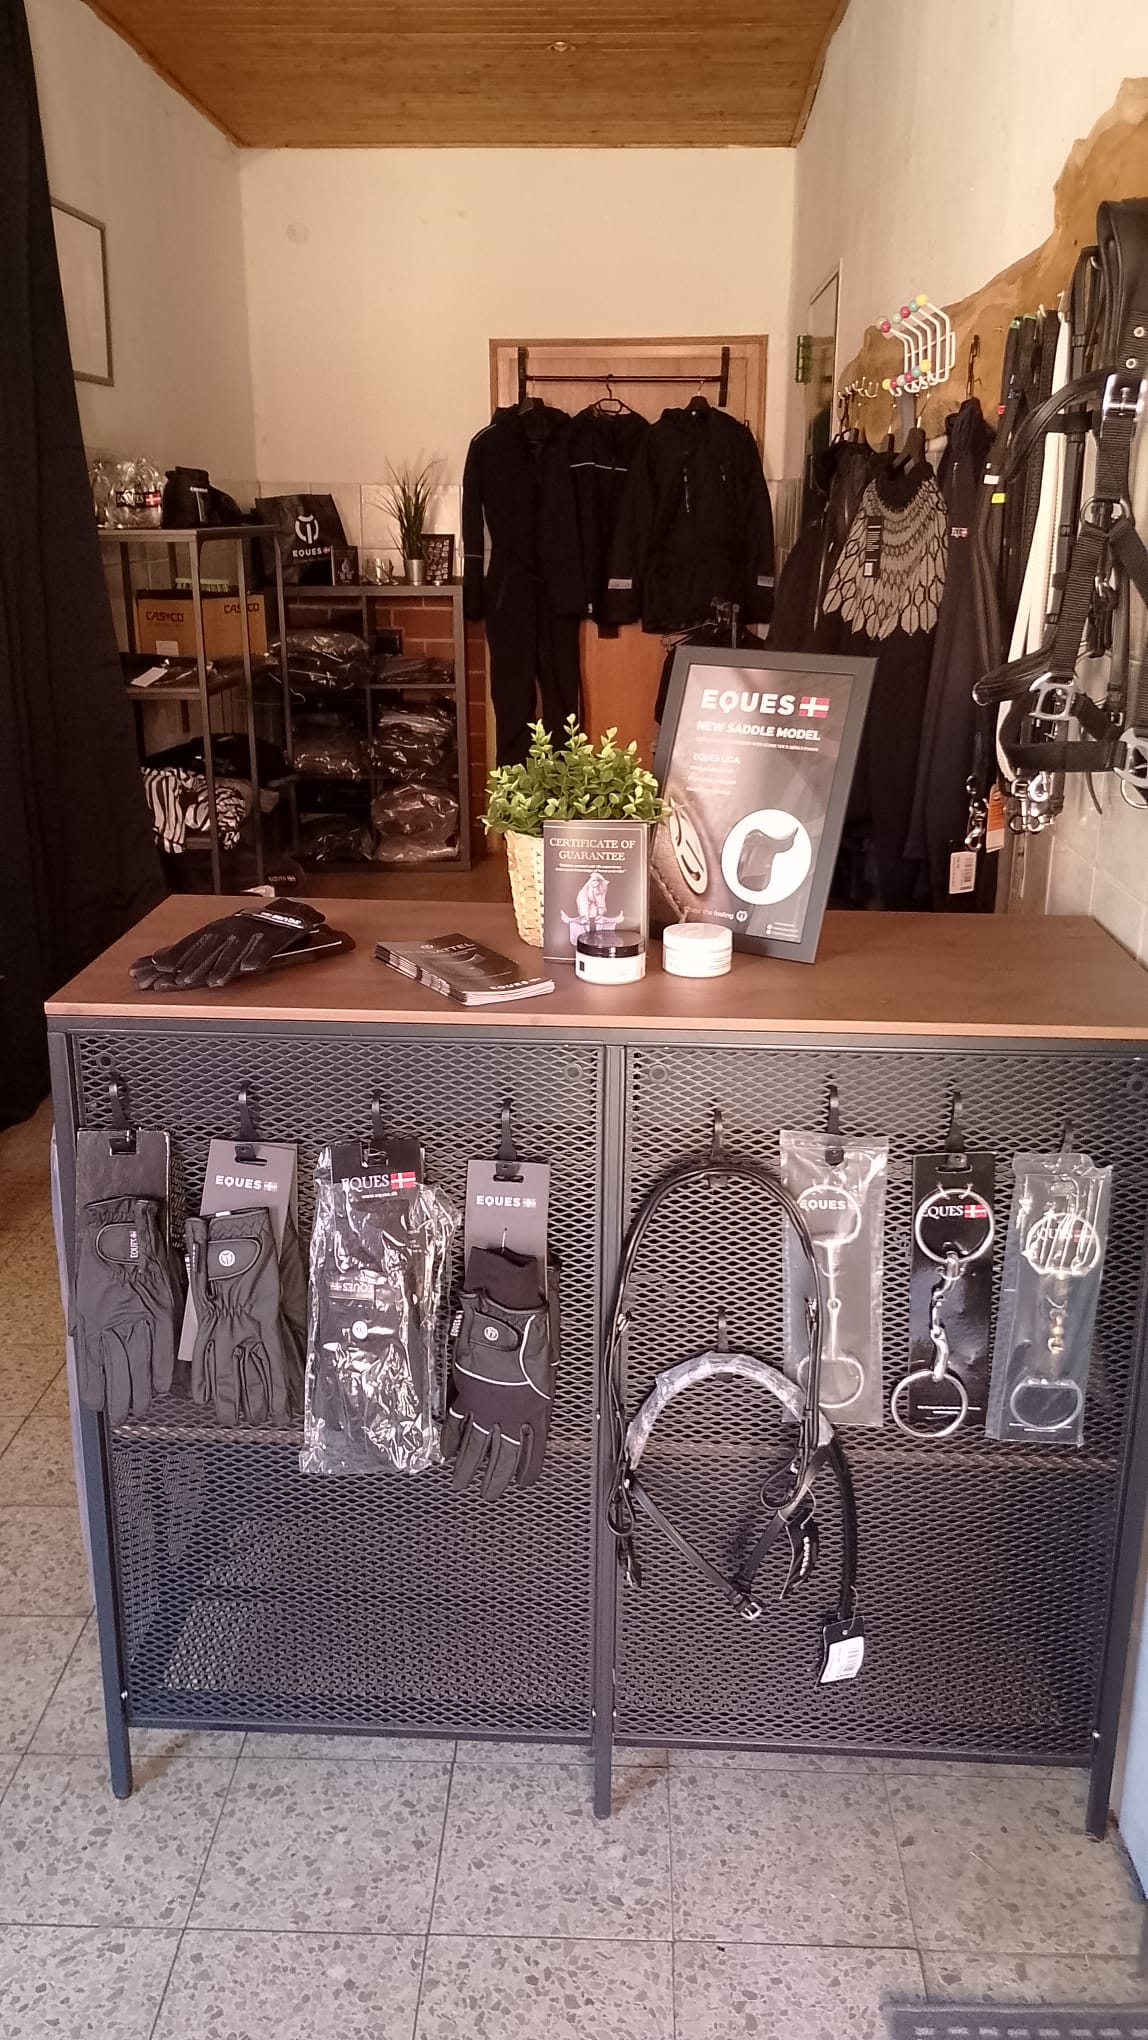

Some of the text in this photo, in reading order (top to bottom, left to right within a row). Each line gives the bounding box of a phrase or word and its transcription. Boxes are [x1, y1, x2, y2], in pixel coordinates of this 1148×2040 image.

[292, 548, 322, 557] EQUES
[701, 689, 796, 716] EQUES
[696, 721, 821, 741] NEW SADDLE MODEL
[549, 837, 636, 849] CERTIFICATE OF
[558, 850, 626, 861] GUARANTEE
[215, 1174, 262, 1190] EQUES
[476, 1195, 521, 1207] EQUES
[799, 1199, 847, 1212] EQUES
